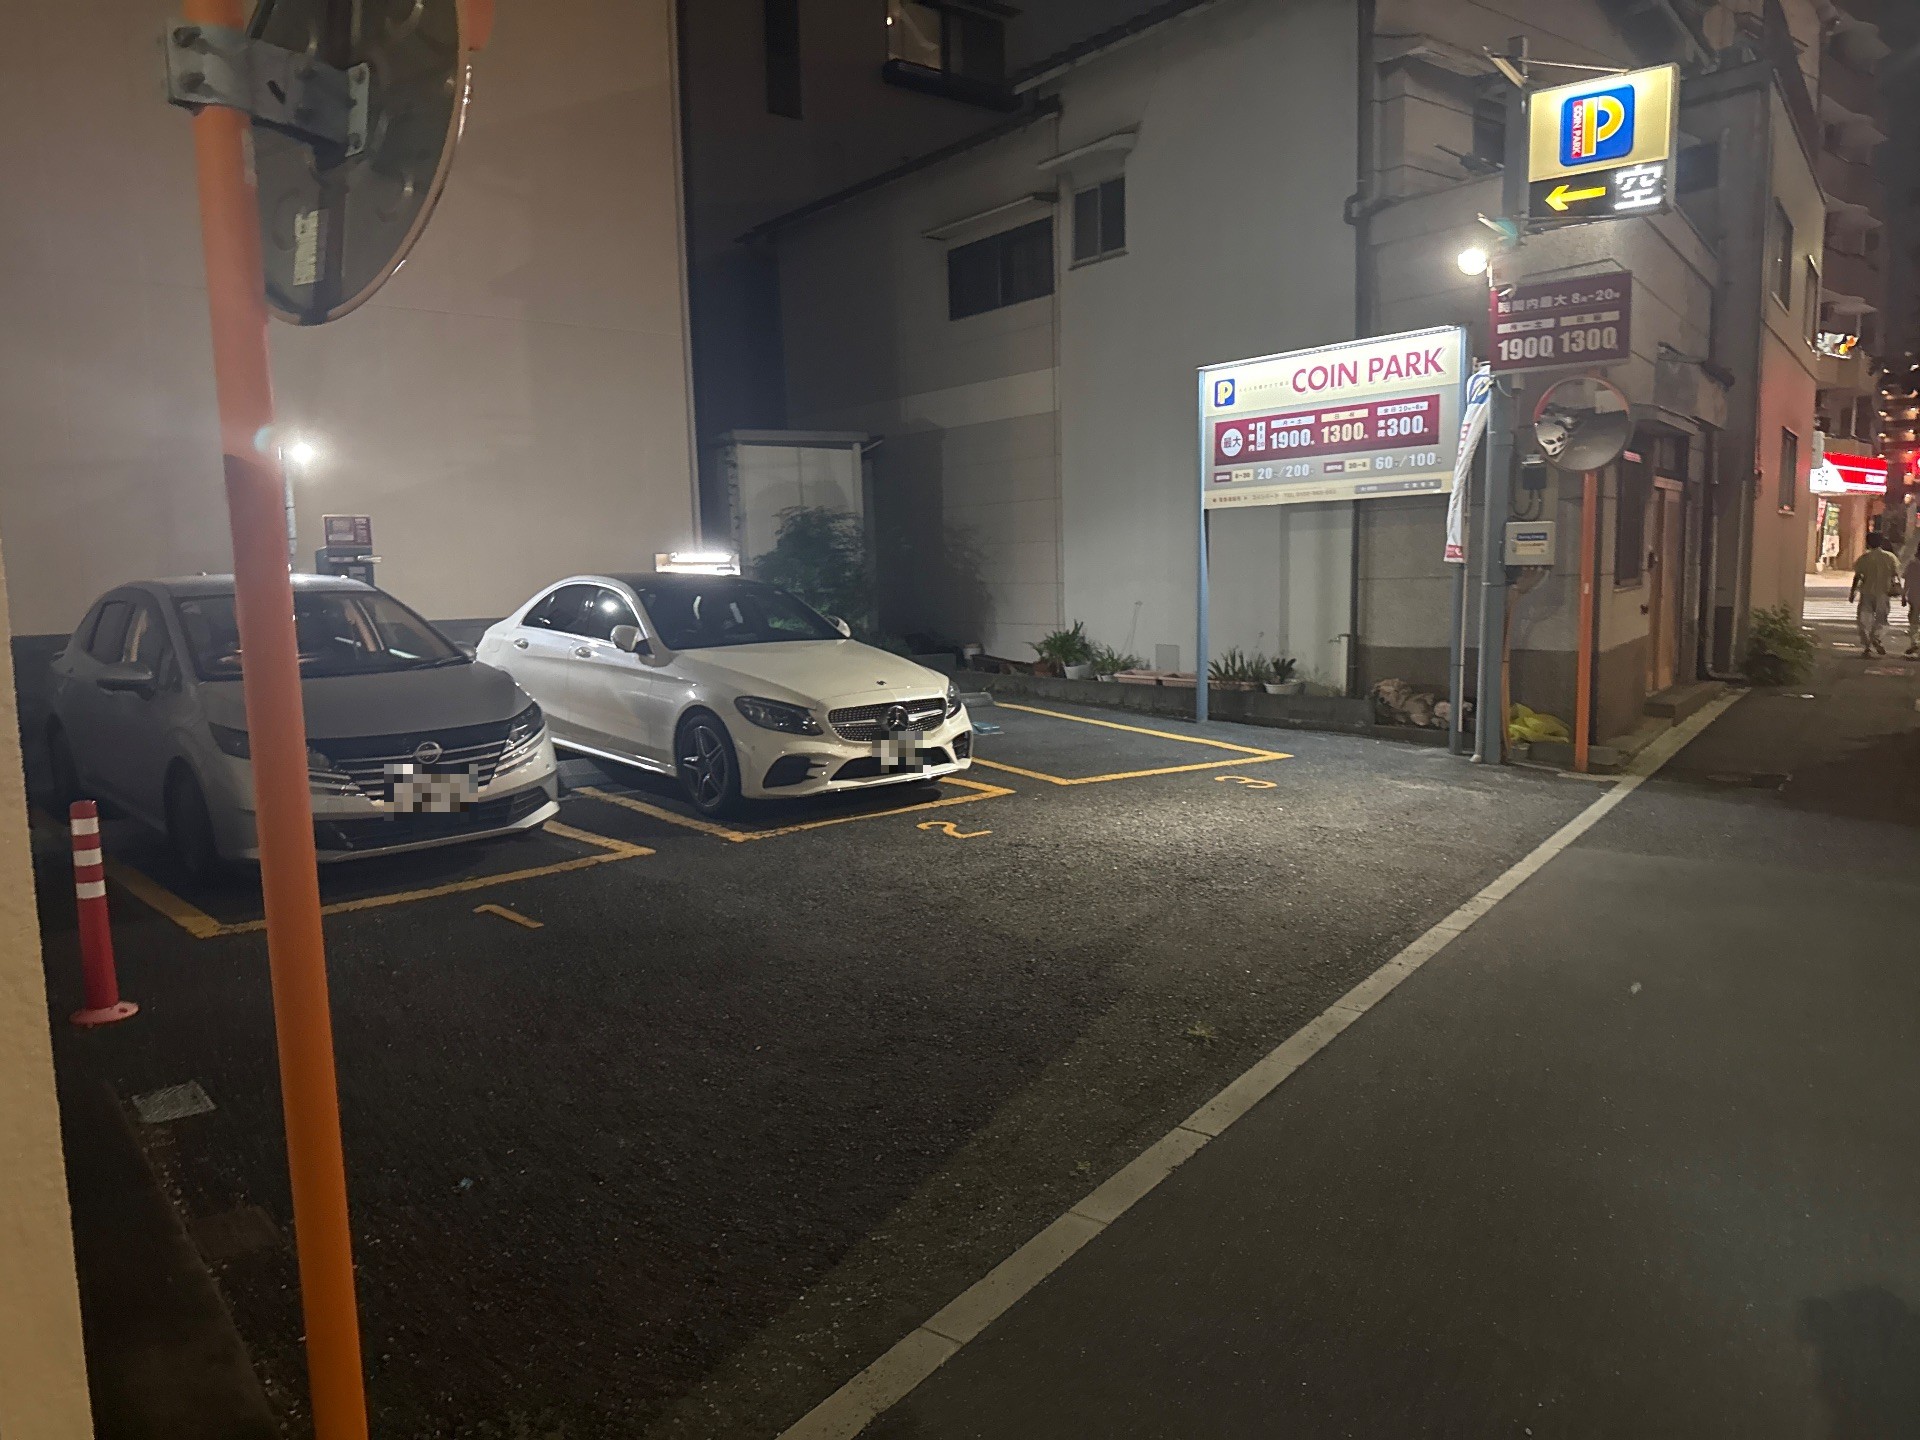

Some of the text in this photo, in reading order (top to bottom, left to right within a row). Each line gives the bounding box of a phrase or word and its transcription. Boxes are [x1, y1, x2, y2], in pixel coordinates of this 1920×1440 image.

[1572, 104, 1583, 154] COIN PARK
[1613, 164, 1663, 211] 空
[1292, 347, 1445, 393] COIN PARK
[1223, 435, 1242, 449] 最大
[1214, 775, 1278, 789] 3
[916, 820, 993, 839] 2
